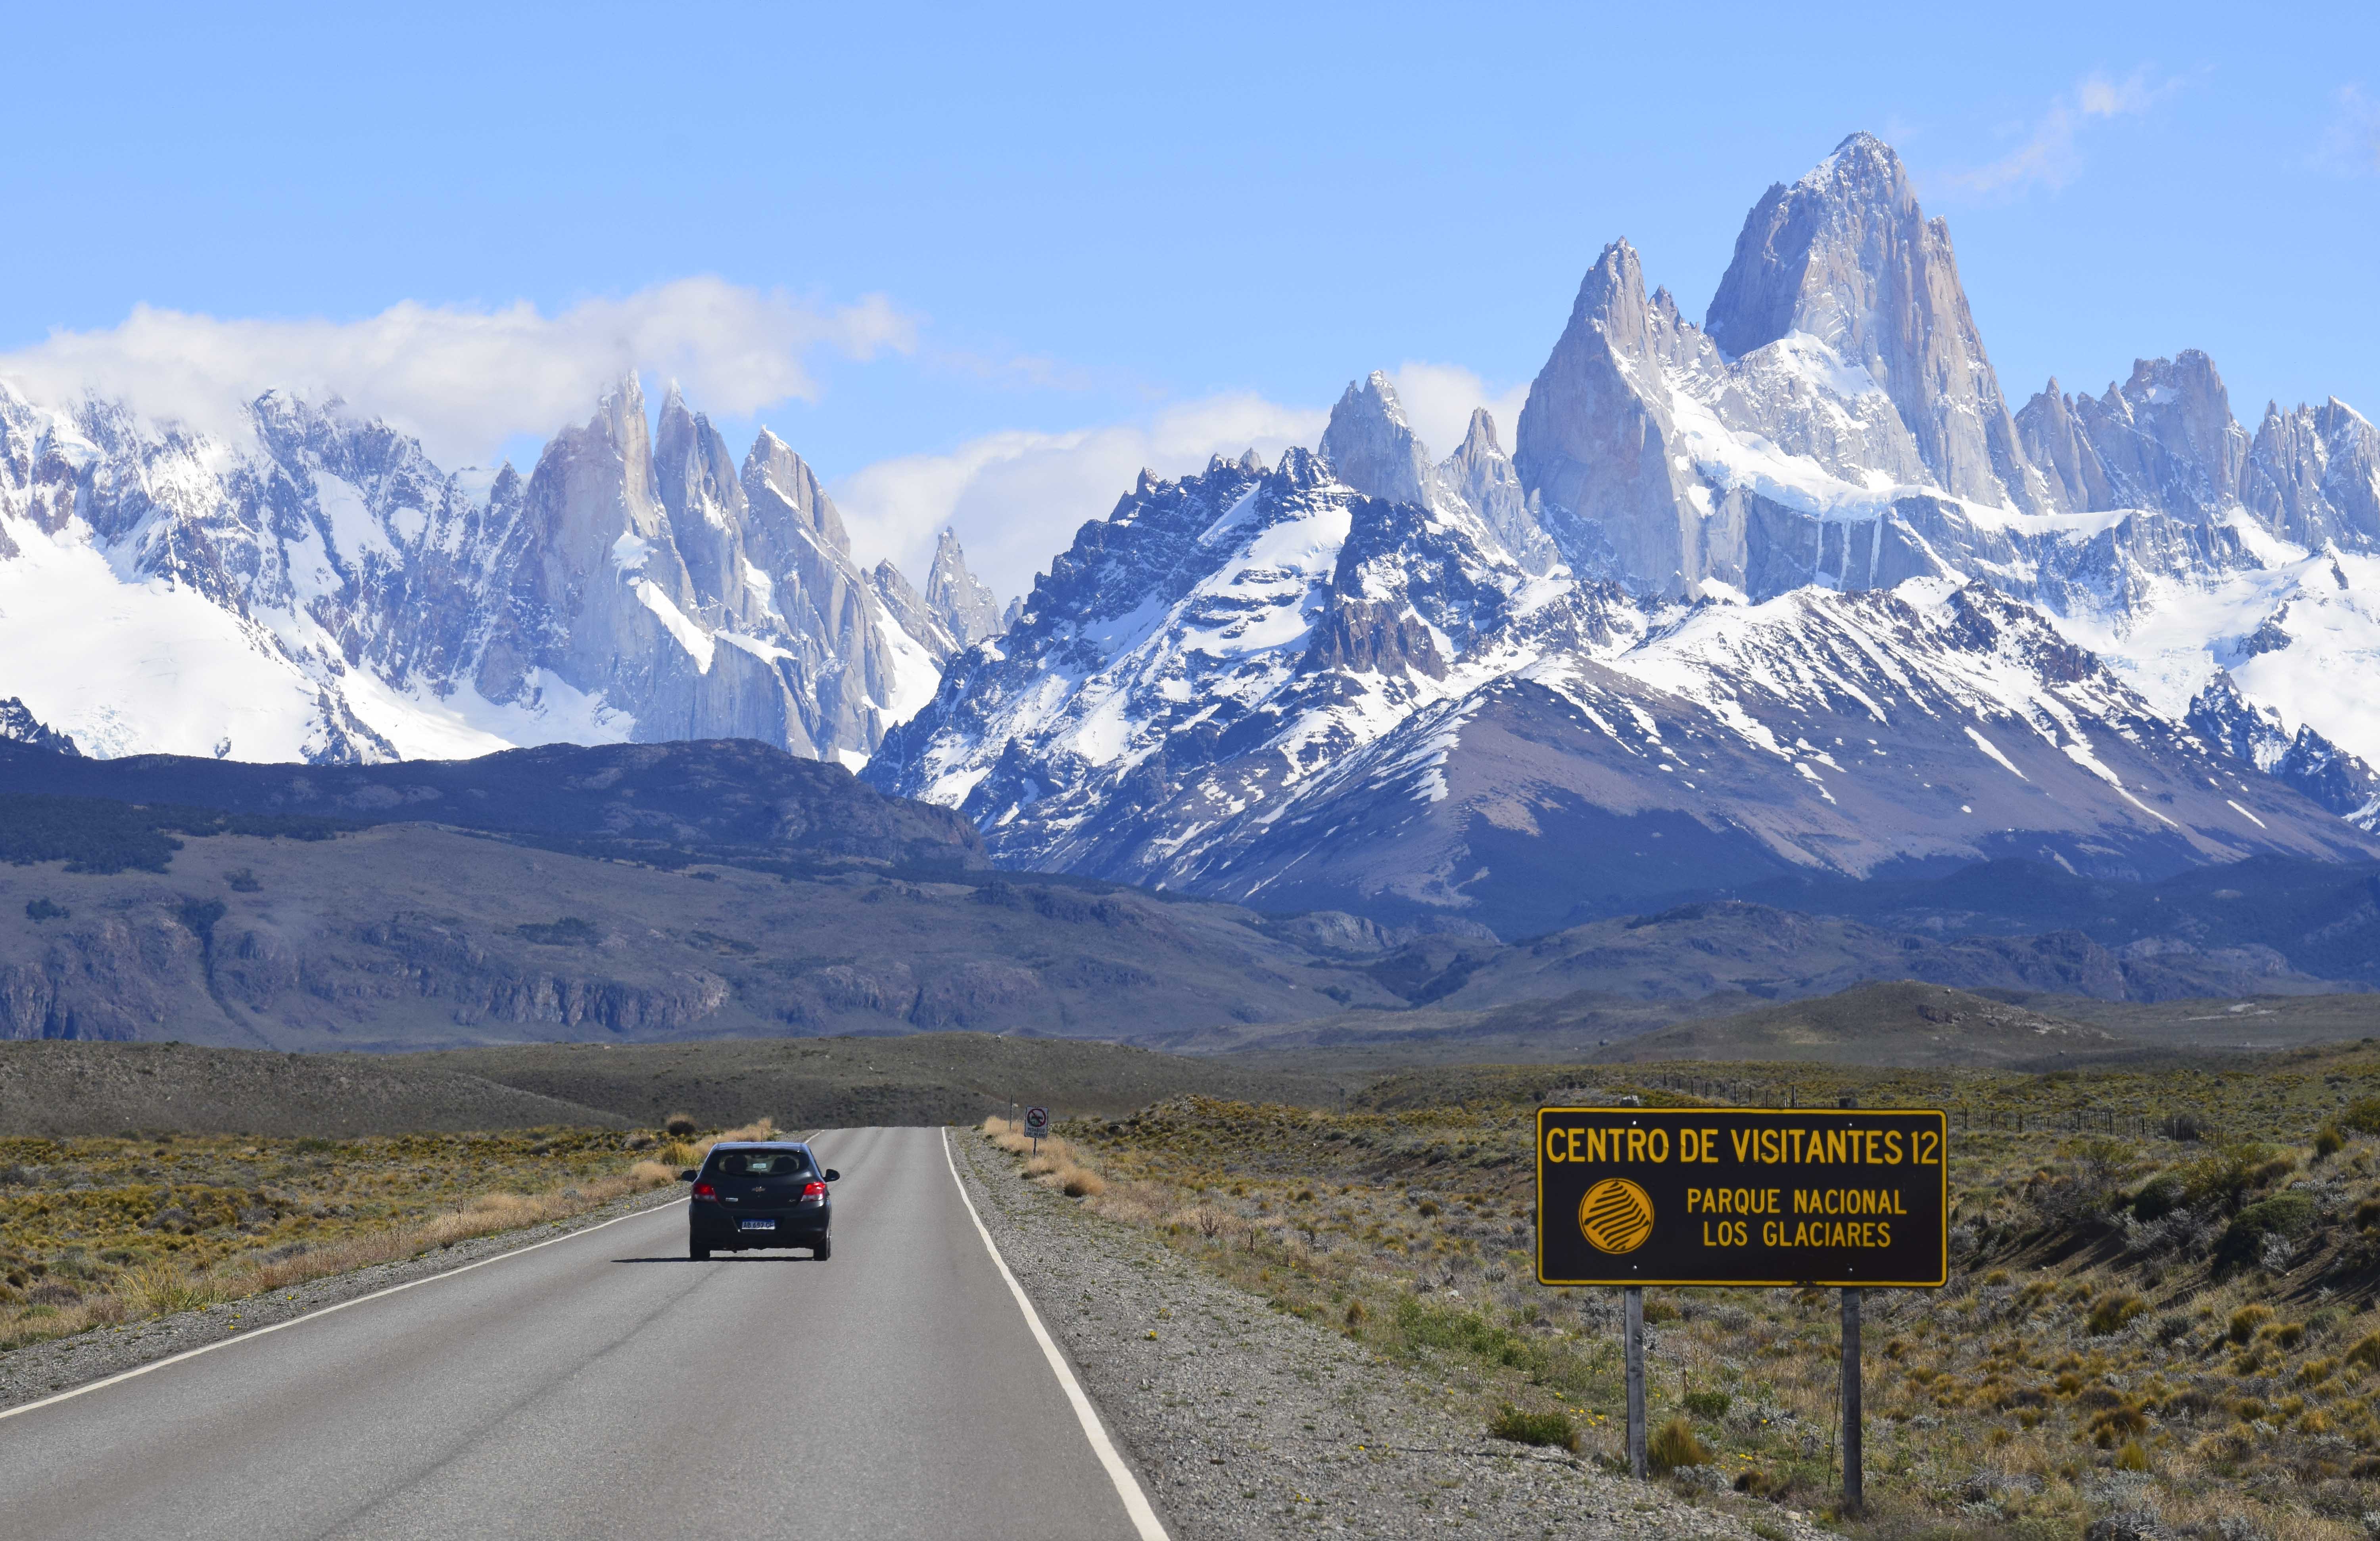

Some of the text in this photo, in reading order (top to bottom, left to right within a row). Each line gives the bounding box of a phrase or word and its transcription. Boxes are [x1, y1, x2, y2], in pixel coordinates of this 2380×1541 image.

[1546, 1127, 1939, 1165] CENTRO DE VISITANTES 12
[1687, 1188, 1907, 1215] PARQUE NACIONAL
[1704, 1221, 1891, 1247] LOS GLACIARES
